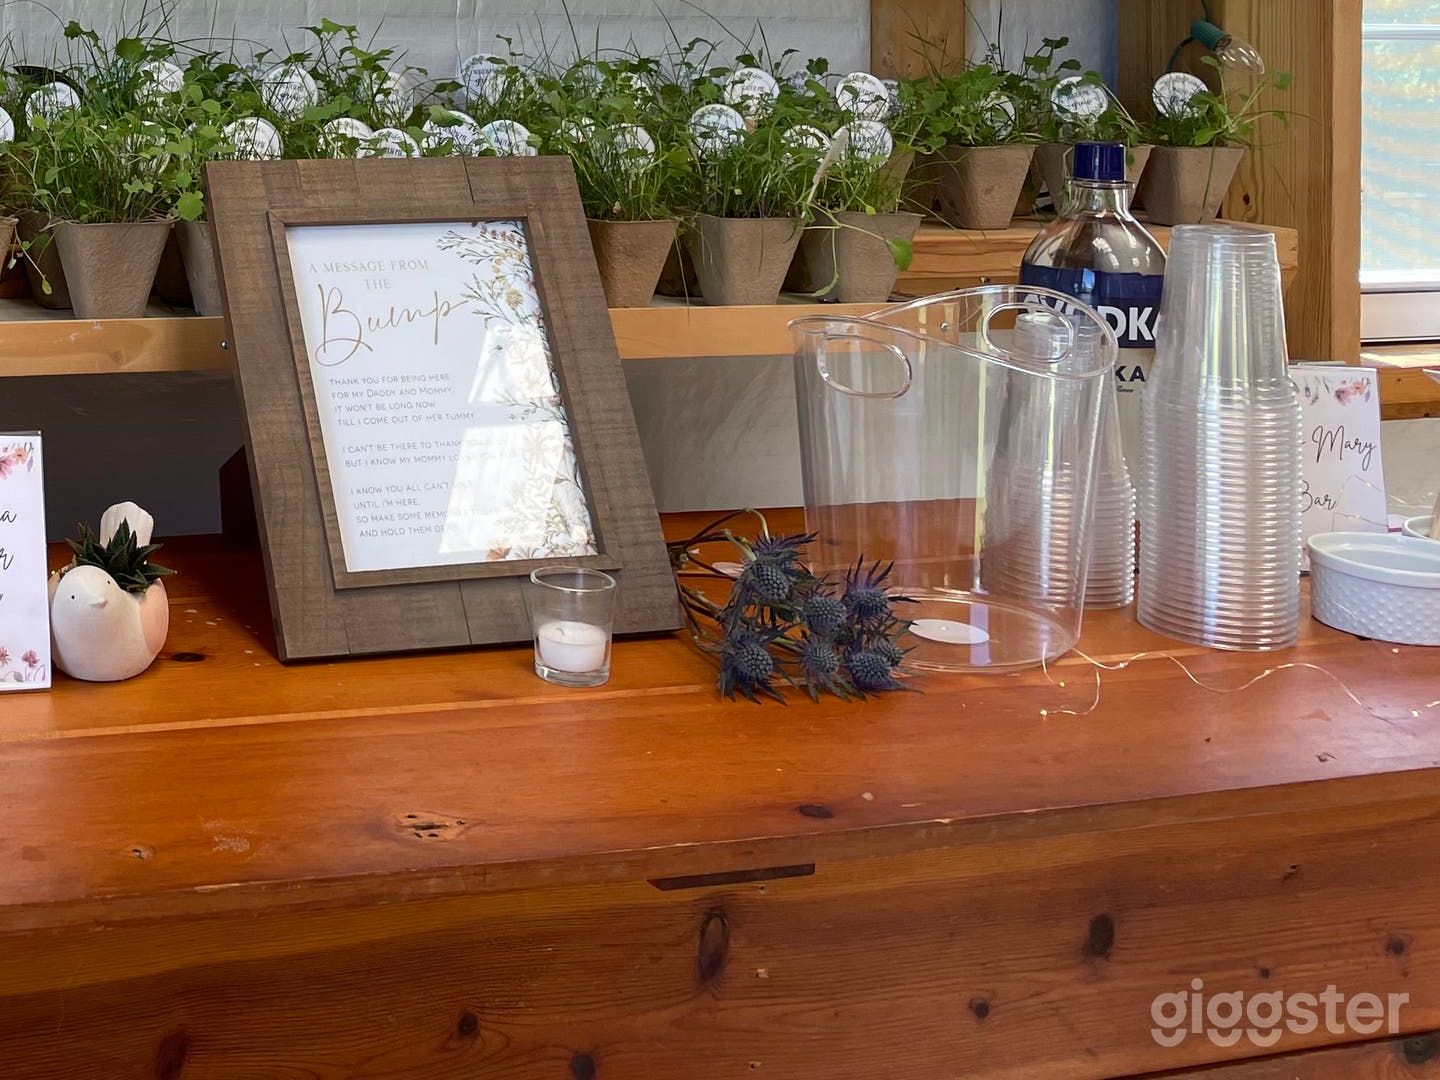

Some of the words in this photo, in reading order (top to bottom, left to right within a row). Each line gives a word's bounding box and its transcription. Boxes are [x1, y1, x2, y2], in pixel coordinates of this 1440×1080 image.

[309, 263, 318, 273] A
[323, 261, 385, 273] MESSAGE
[390, 259, 429, 271] FROM
[364, 279, 392, 290] THE
[315, 284, 469, 367] Bump
[329, 378, 360, 386] THANK
[361, 377, 380, 385] YOU
[381, 375, 399, 384] FOR
[401, 374, 426, 383] BEING
[428, 373, 450, 381] HERE
[331, 392, 350, 400] FOR
[351, 391, 364, 399] MY
[399, 388, 417, 396] AND
[334, 405, 342, 413] IT
[344, 404, 372, 413] WON'T
[375, 403, 386, 411] BE
[389, 401, 413, 410] LONG
[415, 400, 435, 409] NOW
[337, 419, 355, 427] TILL
[363, 416, 389, 425] COME
[392, 416, 409, 424] OUT
[411, 415, 423, 423] OF
[445, 412, 475, 421] TUMMY
[348, 445, 375, 454] CAN'T
[376, 444, 389, 452] BE
[390, 442, 418, 451] THERE
[420, 441, 433, 450] TO
[434, 440, 462, 449] THANK
[1311, 425, 1377, 471] Mary
[345, 460, 362, 468] BUT
[370, 458, 397, 467] KNOW
[399, 457, 411, 465] MY
[414, 455, 447, 464] MOMMY
[356, 487, 383, 496] KNOW
[385, 485, 404, 494] YOU
[406, 484, 422, 492] ALL
[423, 482, 450, 491] CAN'T
[353, 501, 380, 510] UNTIL
[382, 500, 394, 508] I'M
[356, 516, 369, 524] SO
[371, 514, 396, 523] MAKE
[398, 512, 423, 521] SOME
[359, 528, 378, 538] AND
[381, 527, 406, 536] HOLD
[408, 525, 432, 535] THEM
